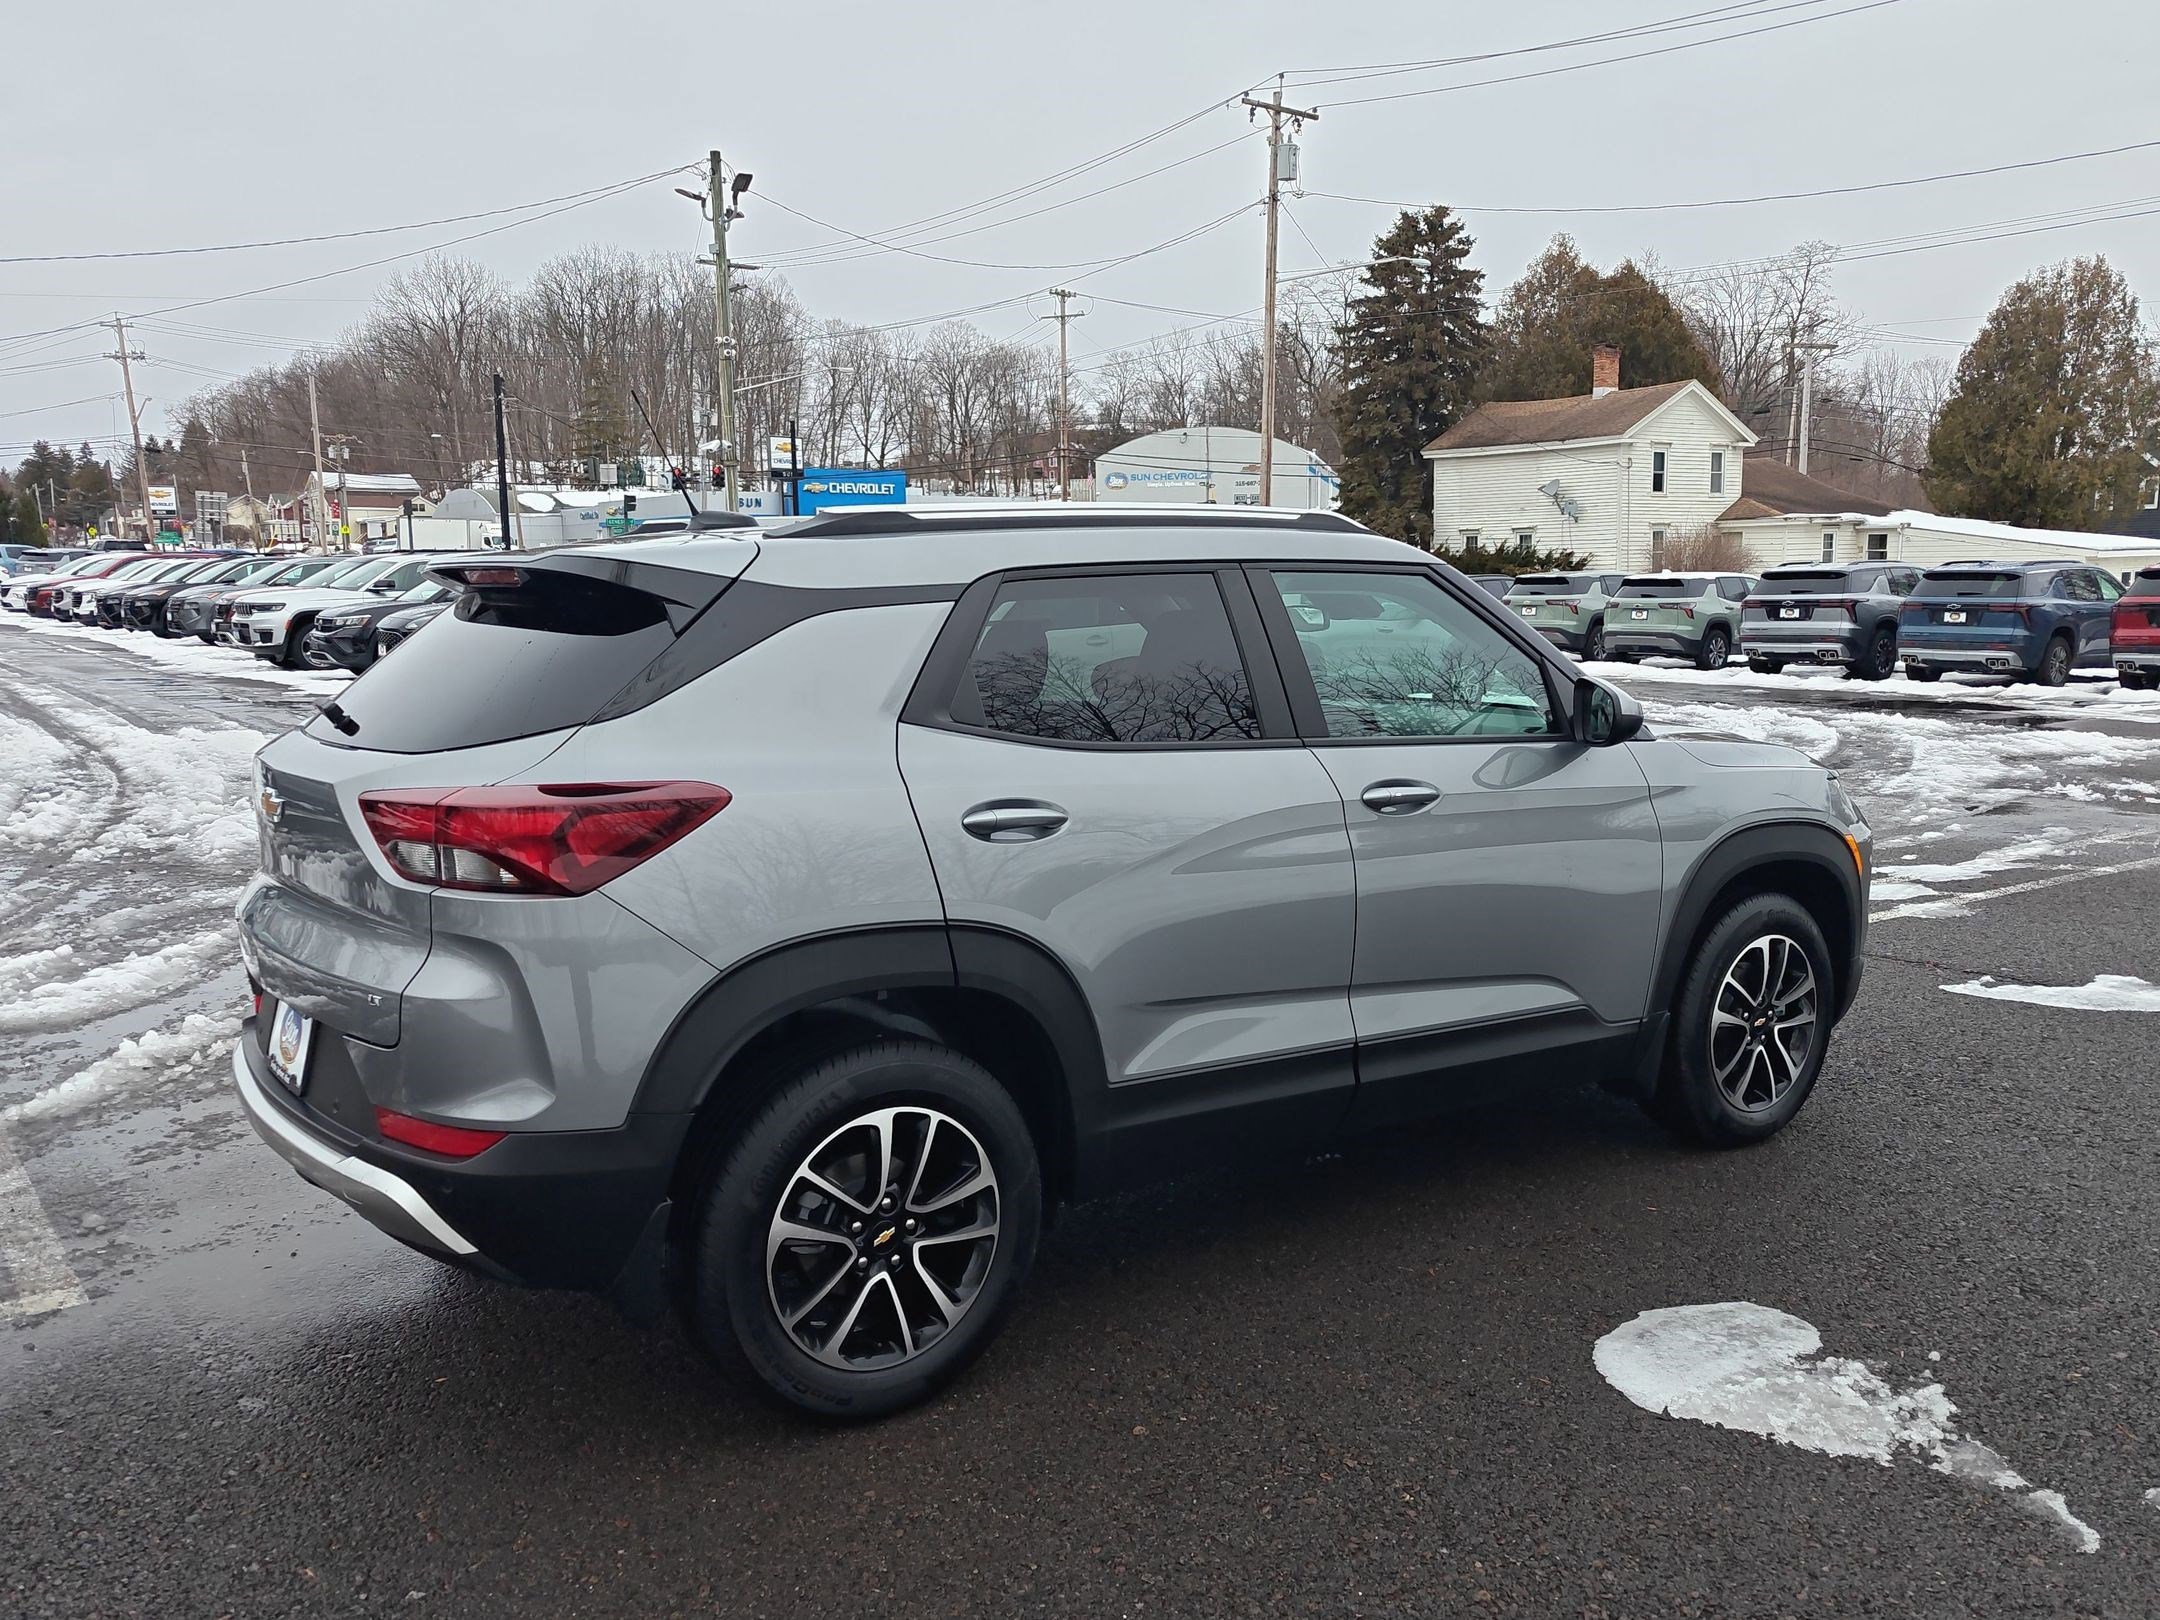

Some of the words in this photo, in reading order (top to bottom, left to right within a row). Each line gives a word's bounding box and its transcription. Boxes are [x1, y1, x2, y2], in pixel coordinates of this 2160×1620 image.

[1130, 473, 1151, 481] SUN
[829, 482, 896, 495] CHEVROLET
[738, 497, 762, 509] SUN
[367, 993, 383, 1007] LT
